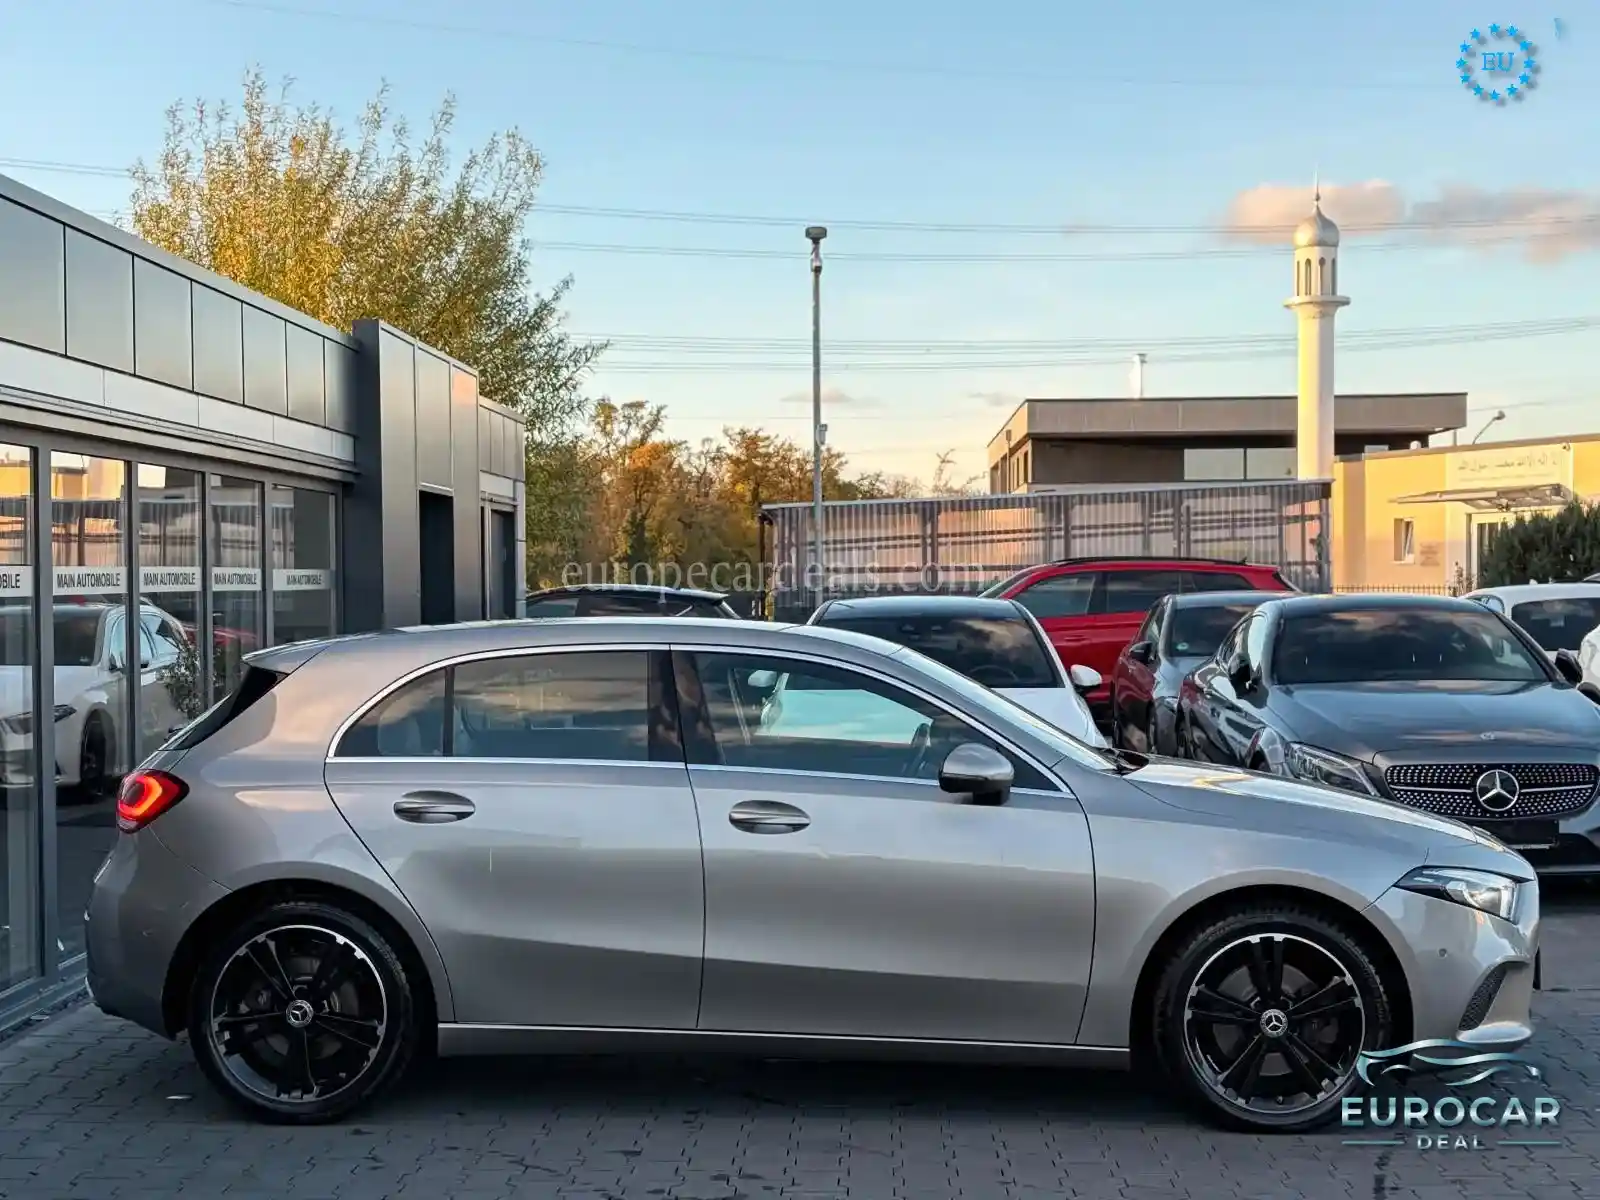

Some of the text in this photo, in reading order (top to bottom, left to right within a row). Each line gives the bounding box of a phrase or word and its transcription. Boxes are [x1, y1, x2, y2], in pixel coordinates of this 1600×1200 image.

[57, 572, 121, 588] MAIN AUTOMOBILE
[143, 572, 196, 586] MAIN AUTOMOBILE
[214, 573, 257, 585] MAIN AUTOMOBILE
